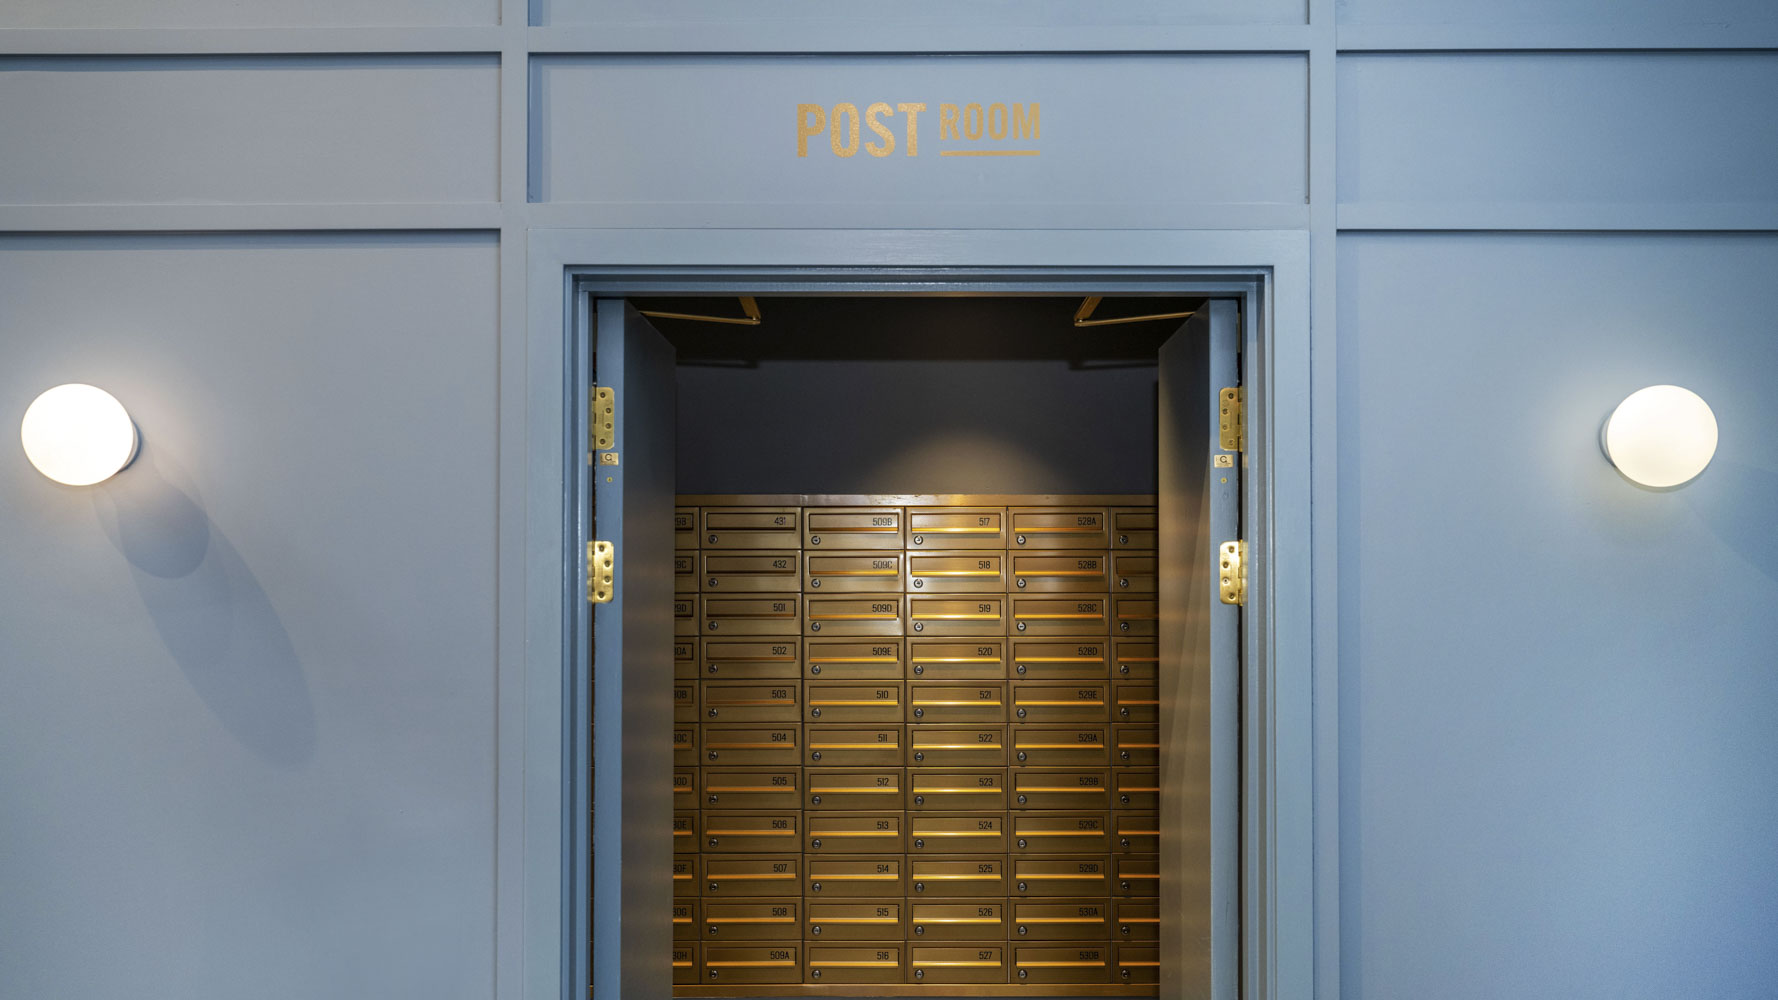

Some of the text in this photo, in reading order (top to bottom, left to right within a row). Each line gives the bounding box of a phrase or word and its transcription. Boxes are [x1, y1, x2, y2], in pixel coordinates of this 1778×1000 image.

[797, 102, 1041, 158] POST ROOM
[675, 517, 687, 526] 9B
[774, 517, 786, 526] 431
[872, 517, 893, 526] 509B
[979, 517, 991, 526] 517
[1077, 517, 1097, 526] 528A
[772, 560, 787, 569] 432
[872, 560, 893, 569] 509C
[978, 560, 991, 569] 518
[773, 603, 786, 612] 501
[872, 603, 892, 612] 509D
[978, 603, 991, 612] 519
[1078, 603, 1097, 612] 528C
[772, 646, 787, 655] 502
[872, 647, 892, 656] 509E
[977, 647, 993, 656] 520
[1078, 647, 1098, 655] 528D
[772, 690, 787, 699] 503
[876, 690, 889, 699] 510
[979, 690, 991, 699] 521
[772, 733, 787, 742] 504
[878, 734, 888, 743] 511
[978, 734, 993, 743] 522
[1078, 733, 1098, 742] 529A
[772, 777, 787, 786] 505
[877, 777, 889, 786] 512
[979, 777, 993, 786] 523
[772, 820, 787, 829] 506
[877, 821, 889, 829] 513
[979, 821, 993, 829] 524
[773, 864, 788, 872] 507
[877, 864, 889, 873] 514
[978, 864, 993, 873] 525
[772, 907, 787, 916] 508
[877, 908, 889, 917] 515
[978, 908, 993, 917] 526
[1079, 907, 1098, 916] 530A
[770, 951, 790, 960] 509A
[877, 951, 889, 960] 516
[979, 951, 993, 960] 527
